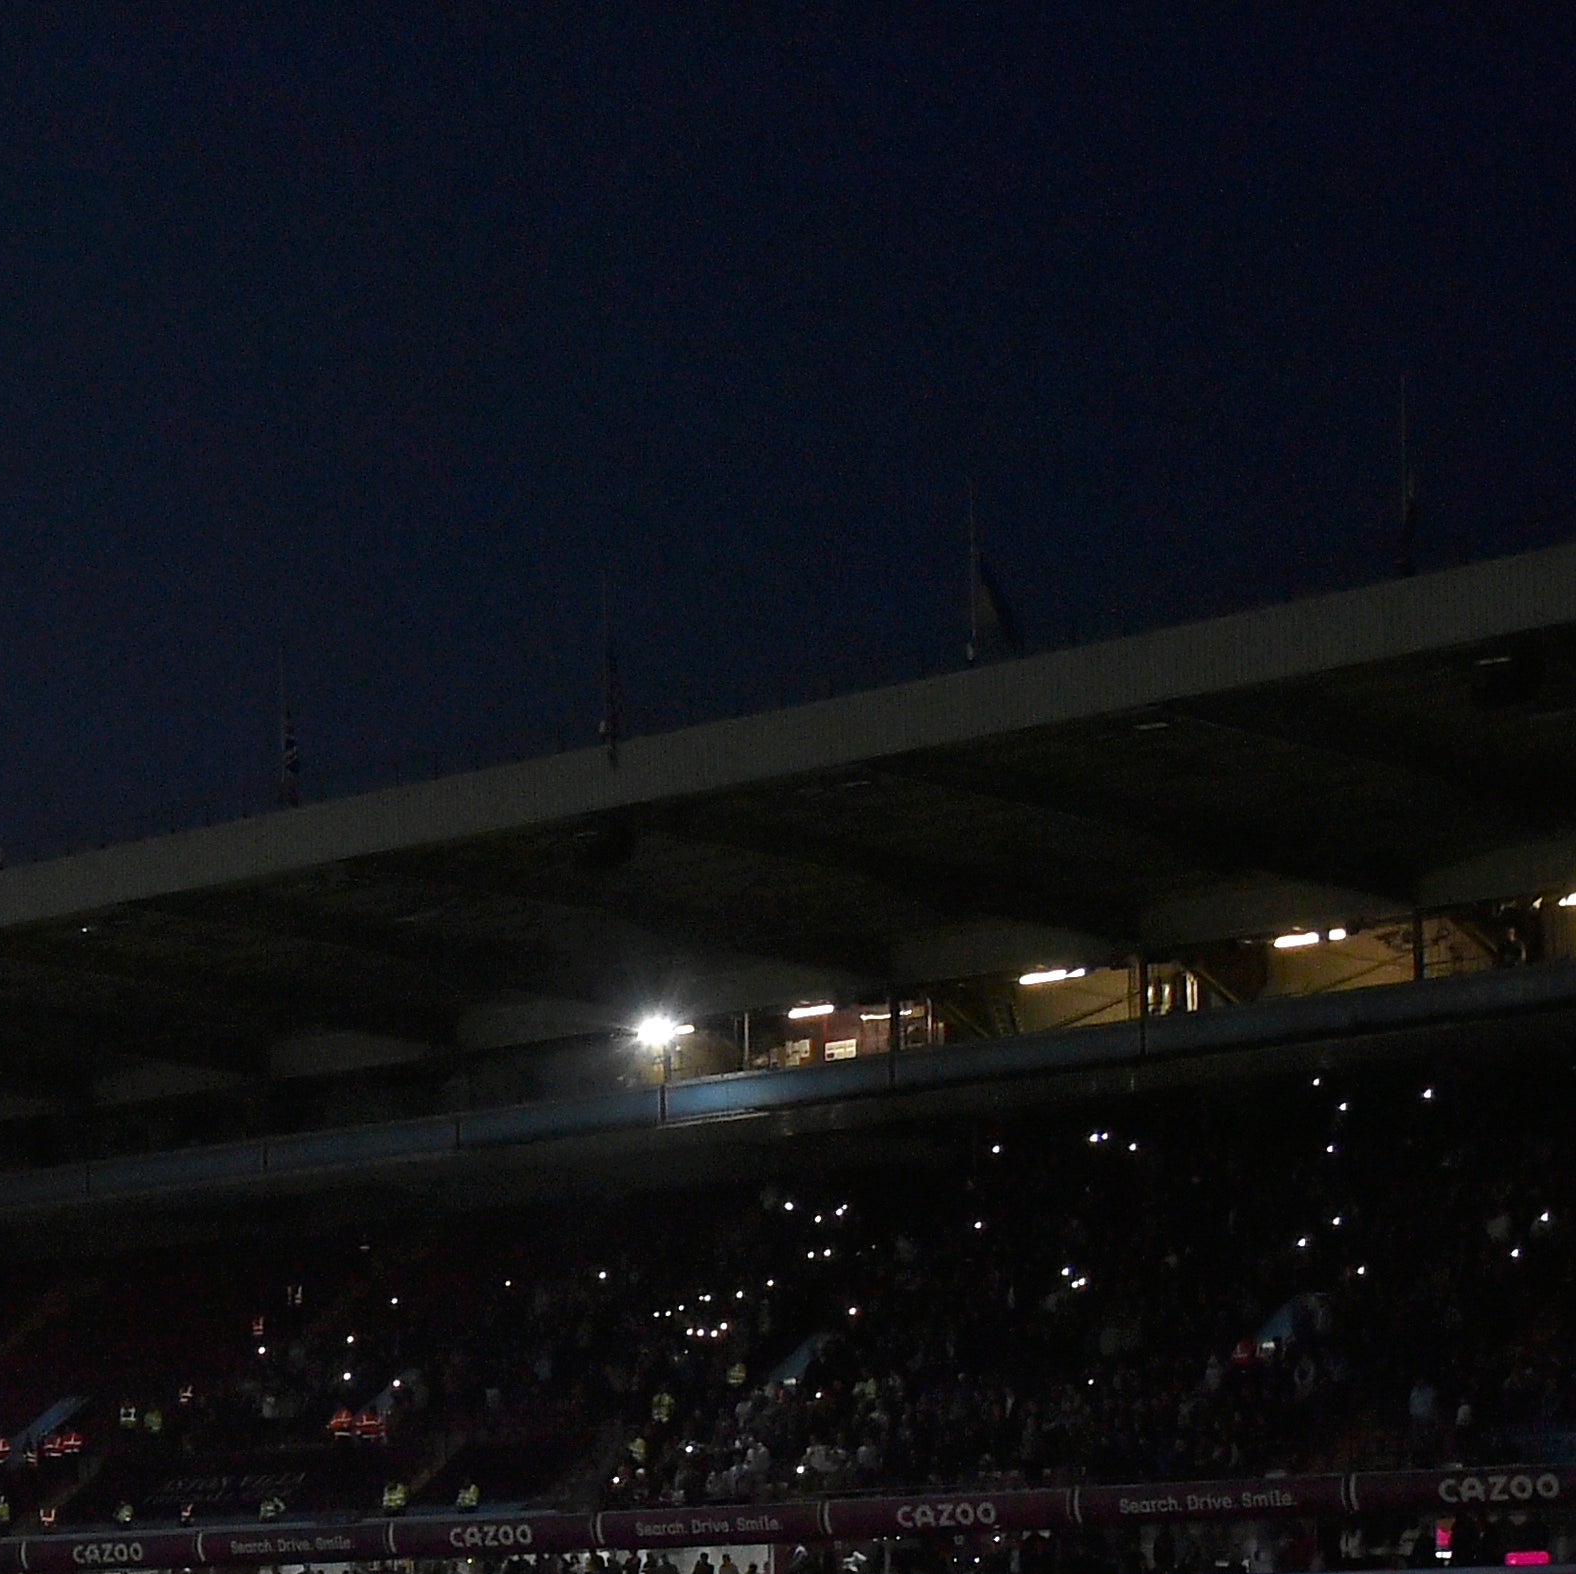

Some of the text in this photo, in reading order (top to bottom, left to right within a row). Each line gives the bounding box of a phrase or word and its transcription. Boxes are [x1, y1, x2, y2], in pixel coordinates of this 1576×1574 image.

[1438, 1473, 1560, 1503] CAZOO
[896, 1501, 996, 1528] CAZOO
[1119, 1496, 1181, 1515] Search.
[1242, 1489, 1297, 1508] Smile.
[449, 1525, 532, 1548] CAZOO
[72, 1542, 144, 1564] CAZOO
